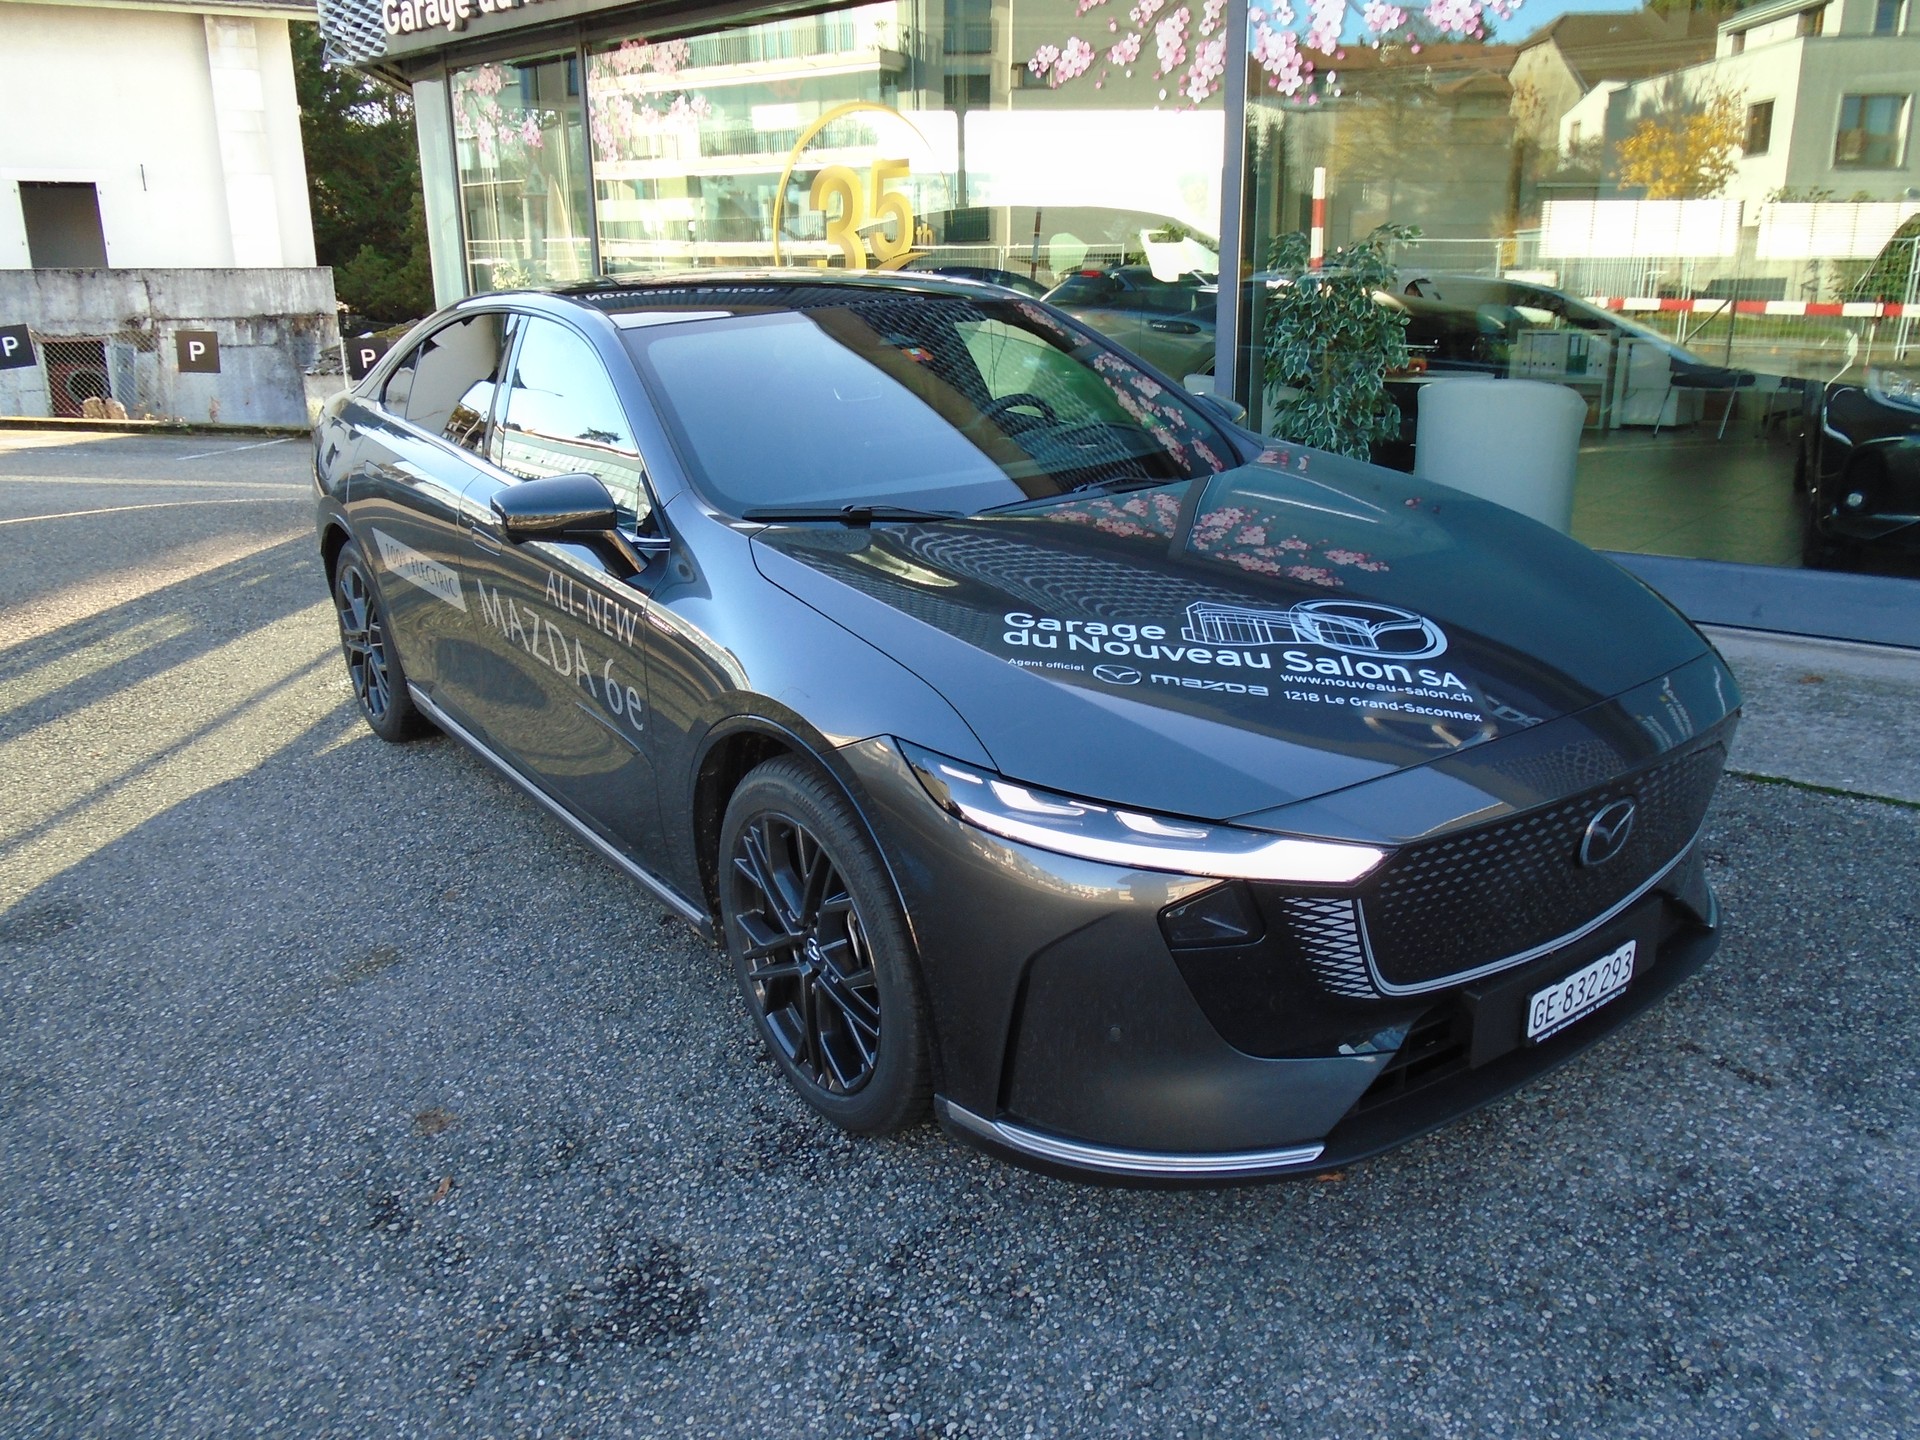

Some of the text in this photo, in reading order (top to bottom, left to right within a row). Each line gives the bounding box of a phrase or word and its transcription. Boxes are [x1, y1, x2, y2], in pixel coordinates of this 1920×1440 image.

[382, 0, 470, 35] Garage
[2, 336, 19, 356] P
[188, 341, 205, 362] P
[360, 348, 376, 369] P
[546, 571, 637, 647] ALL-NEW
[1003, 612, 1167, 642] Garage
[477, 579, 643, 731] MAZDA 6e
[1003, 627, 1467, 691] du Nouveau Salon SA
[1007, 658, 1085, 672] Agent officiel
[1150, 674, 1269, 698] mazda
[1280, 673, 1473, 704] www.nouveau-salon.ch
[1284, 690, 1483, 722] 1218 Le Grand-Saconnex
